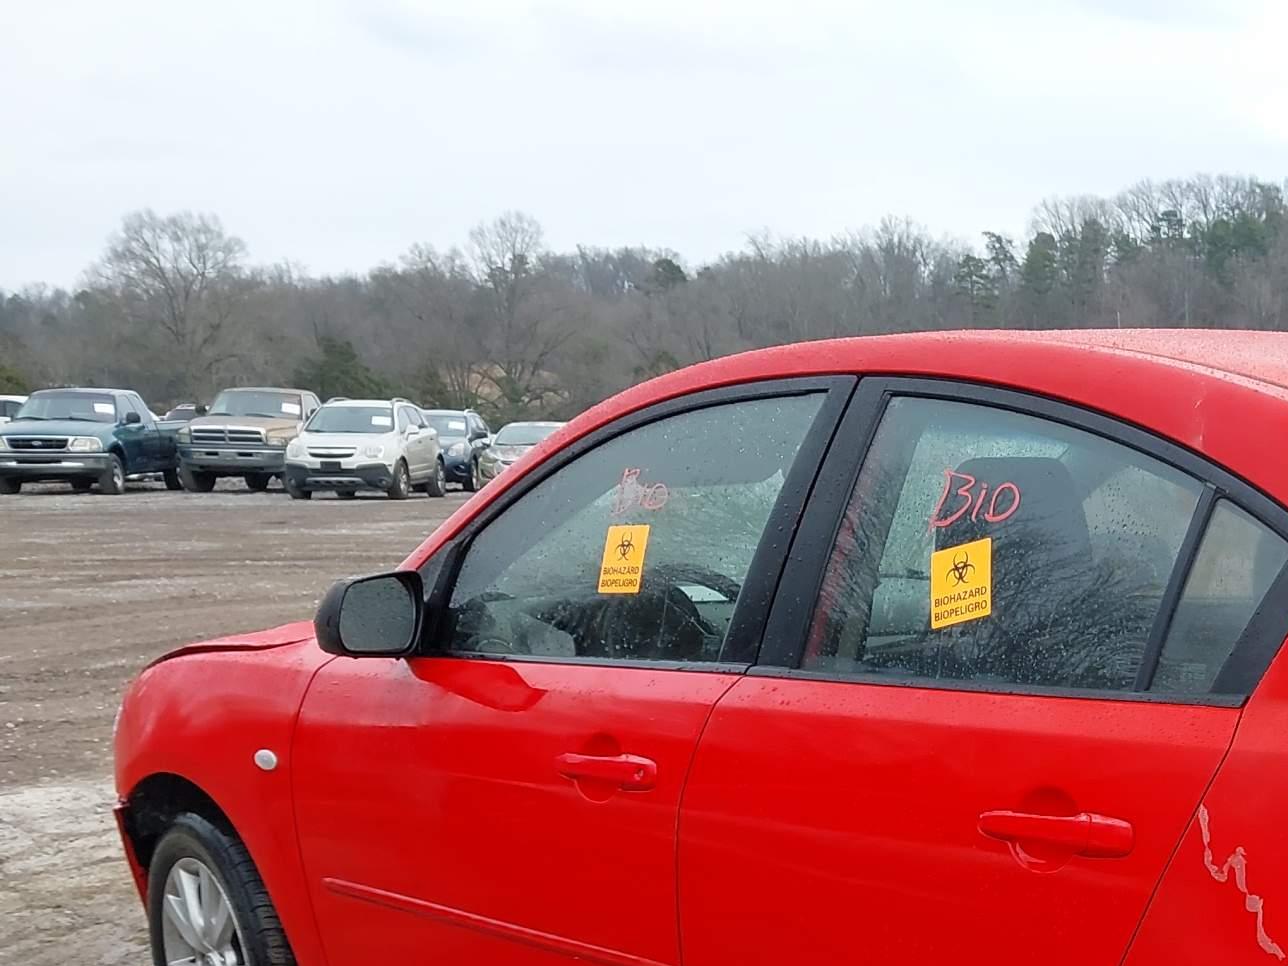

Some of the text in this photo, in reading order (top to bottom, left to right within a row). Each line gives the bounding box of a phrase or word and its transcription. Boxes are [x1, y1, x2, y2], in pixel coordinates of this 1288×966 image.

[602, 565, 639, 576] BIOHAZARD
[600, 577, 638, 588] BIOPELIGRO
[934, 586, 987, 607] BIOHAZARD
[934, 600, 988, 622] BIOPELIGRO
